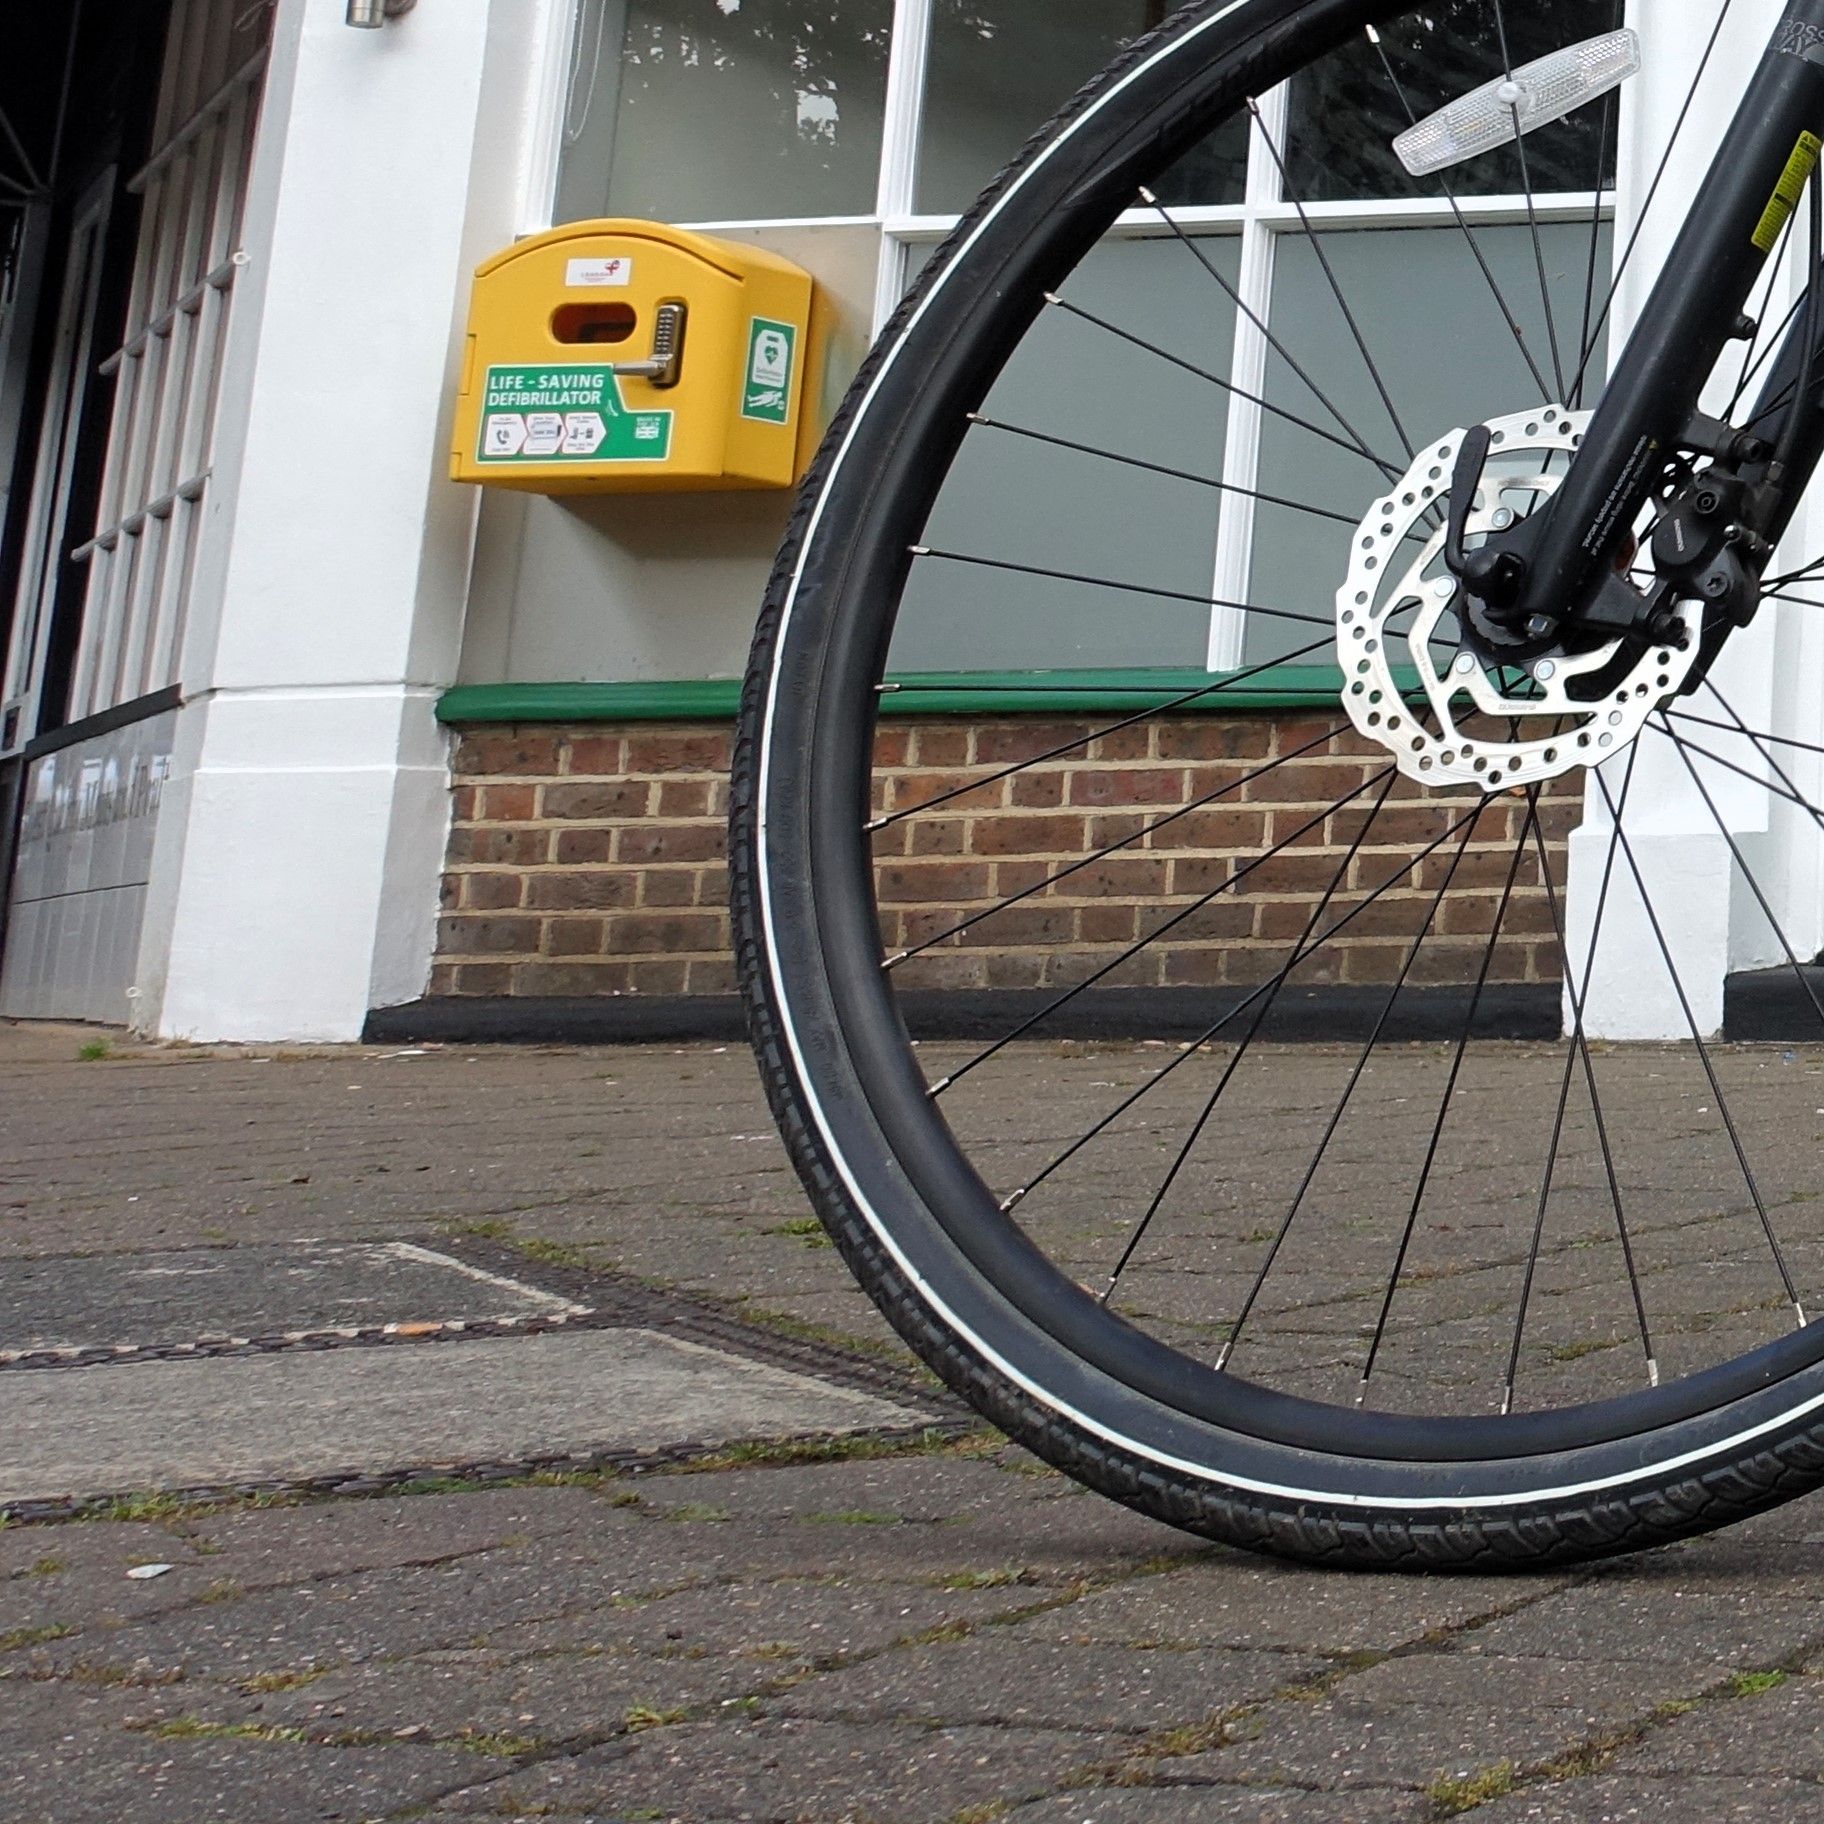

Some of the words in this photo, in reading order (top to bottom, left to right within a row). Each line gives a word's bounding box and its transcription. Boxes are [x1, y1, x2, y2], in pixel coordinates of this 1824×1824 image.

[490, 375, 525, 390] LIFE
[538, 374, 605, 389] SAVING
[487, 391, 602, 407] DEFIBRILLATOR
